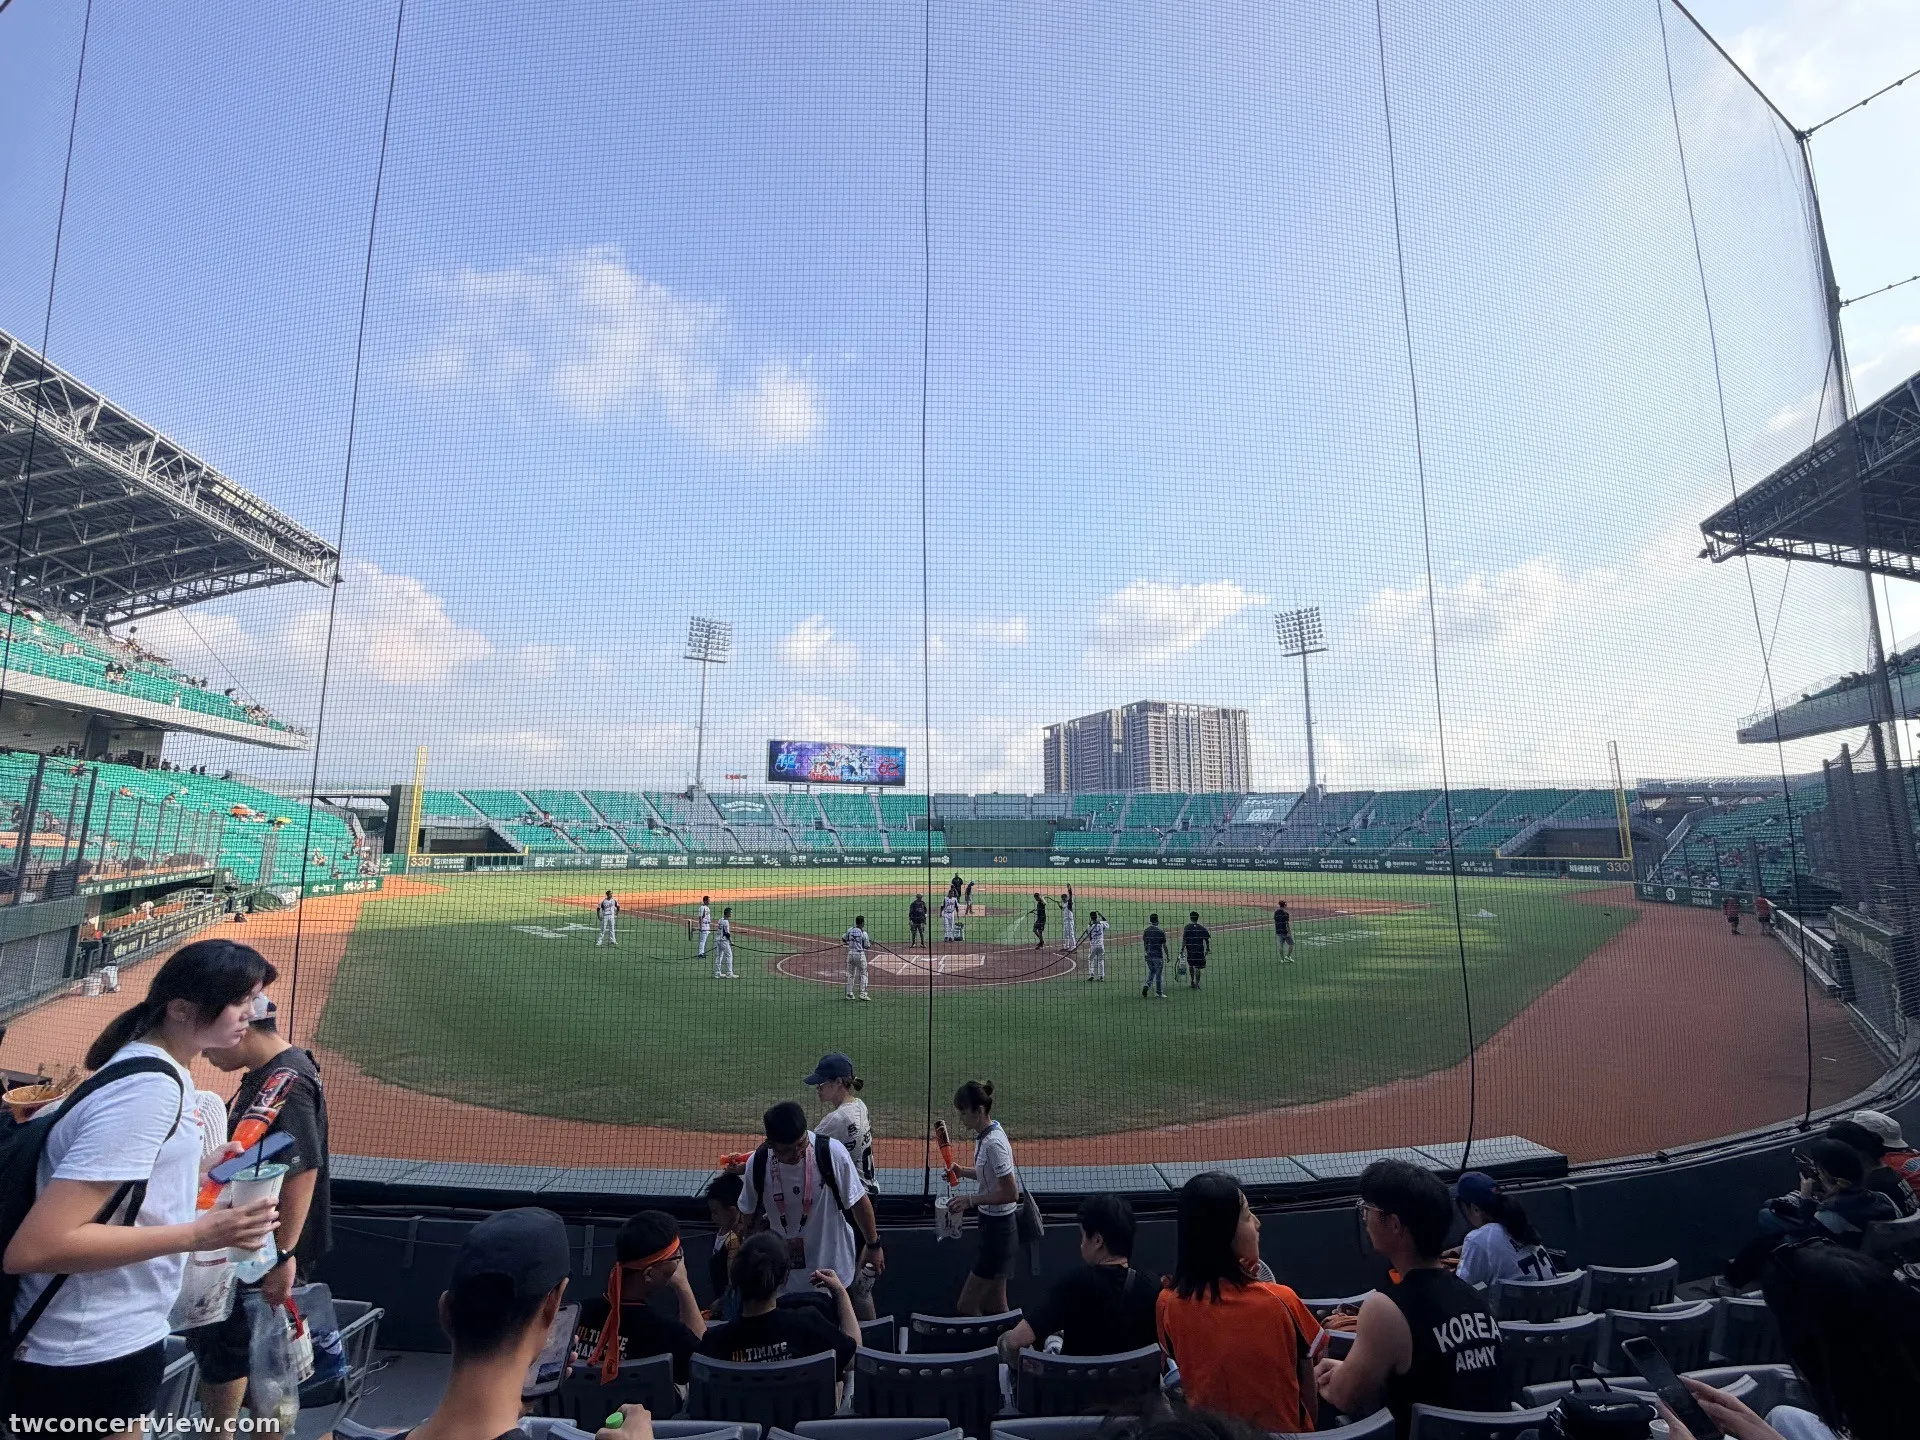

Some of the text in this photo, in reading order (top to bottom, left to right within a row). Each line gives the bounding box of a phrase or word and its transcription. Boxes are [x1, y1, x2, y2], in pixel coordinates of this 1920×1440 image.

[410, 857, 431, 867] 330
[1606, 861, 1630, 872] 330
[576, 1325, 629, 1352] ULTIE
[1432, 1312, 1503, 1353] KOREA
[731, 1341, 788, 1363] ULTIMATE
[1455, 1345, 1497, 1373] ARMY
